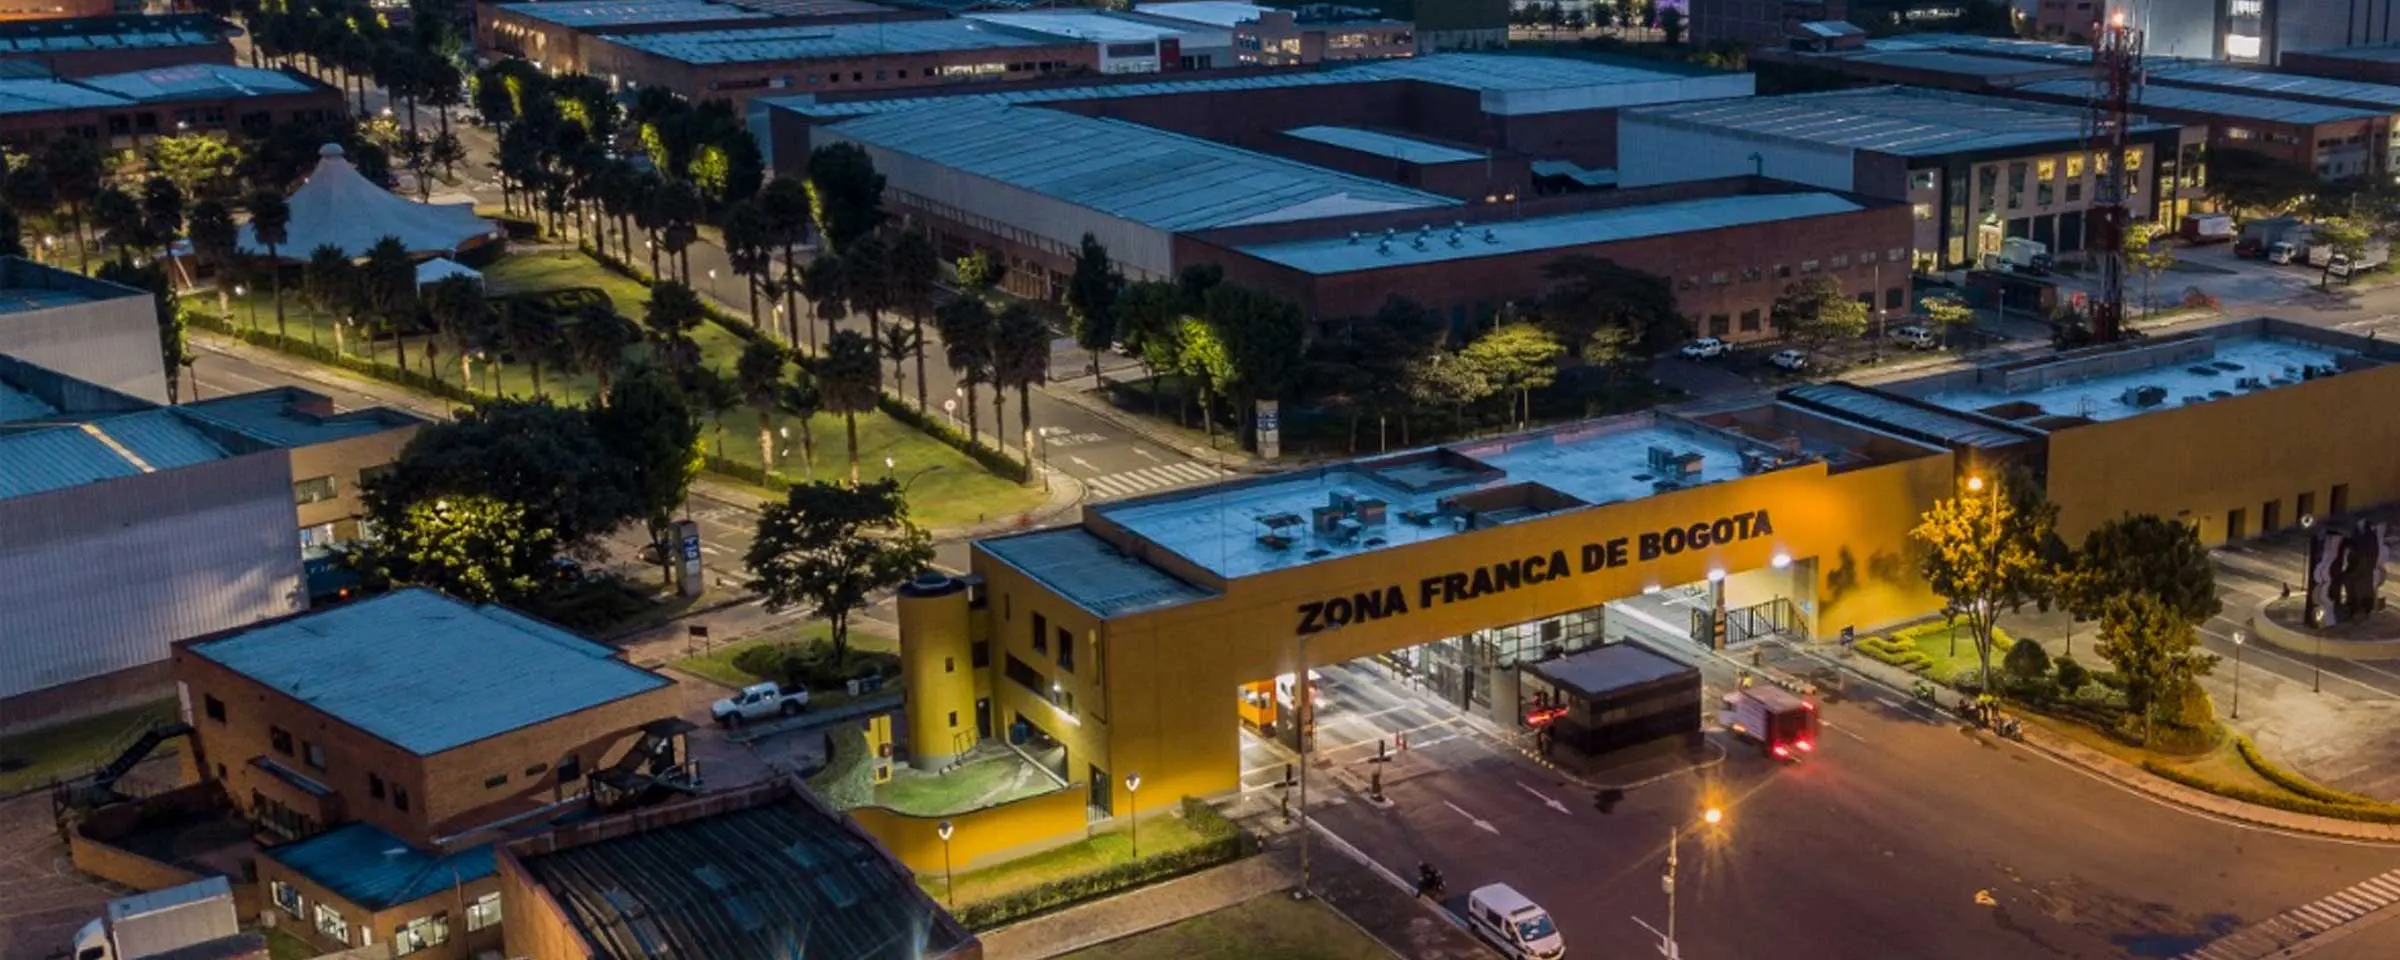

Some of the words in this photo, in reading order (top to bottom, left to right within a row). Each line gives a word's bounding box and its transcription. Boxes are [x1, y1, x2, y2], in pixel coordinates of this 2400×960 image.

[1296, 585, 1408, 635] ZONA
[1420, 550, 1570, 608] FRANCA
[1582, 537, 1629, 573] DE
[1639, 509, 1773, 561] BOGOTA
